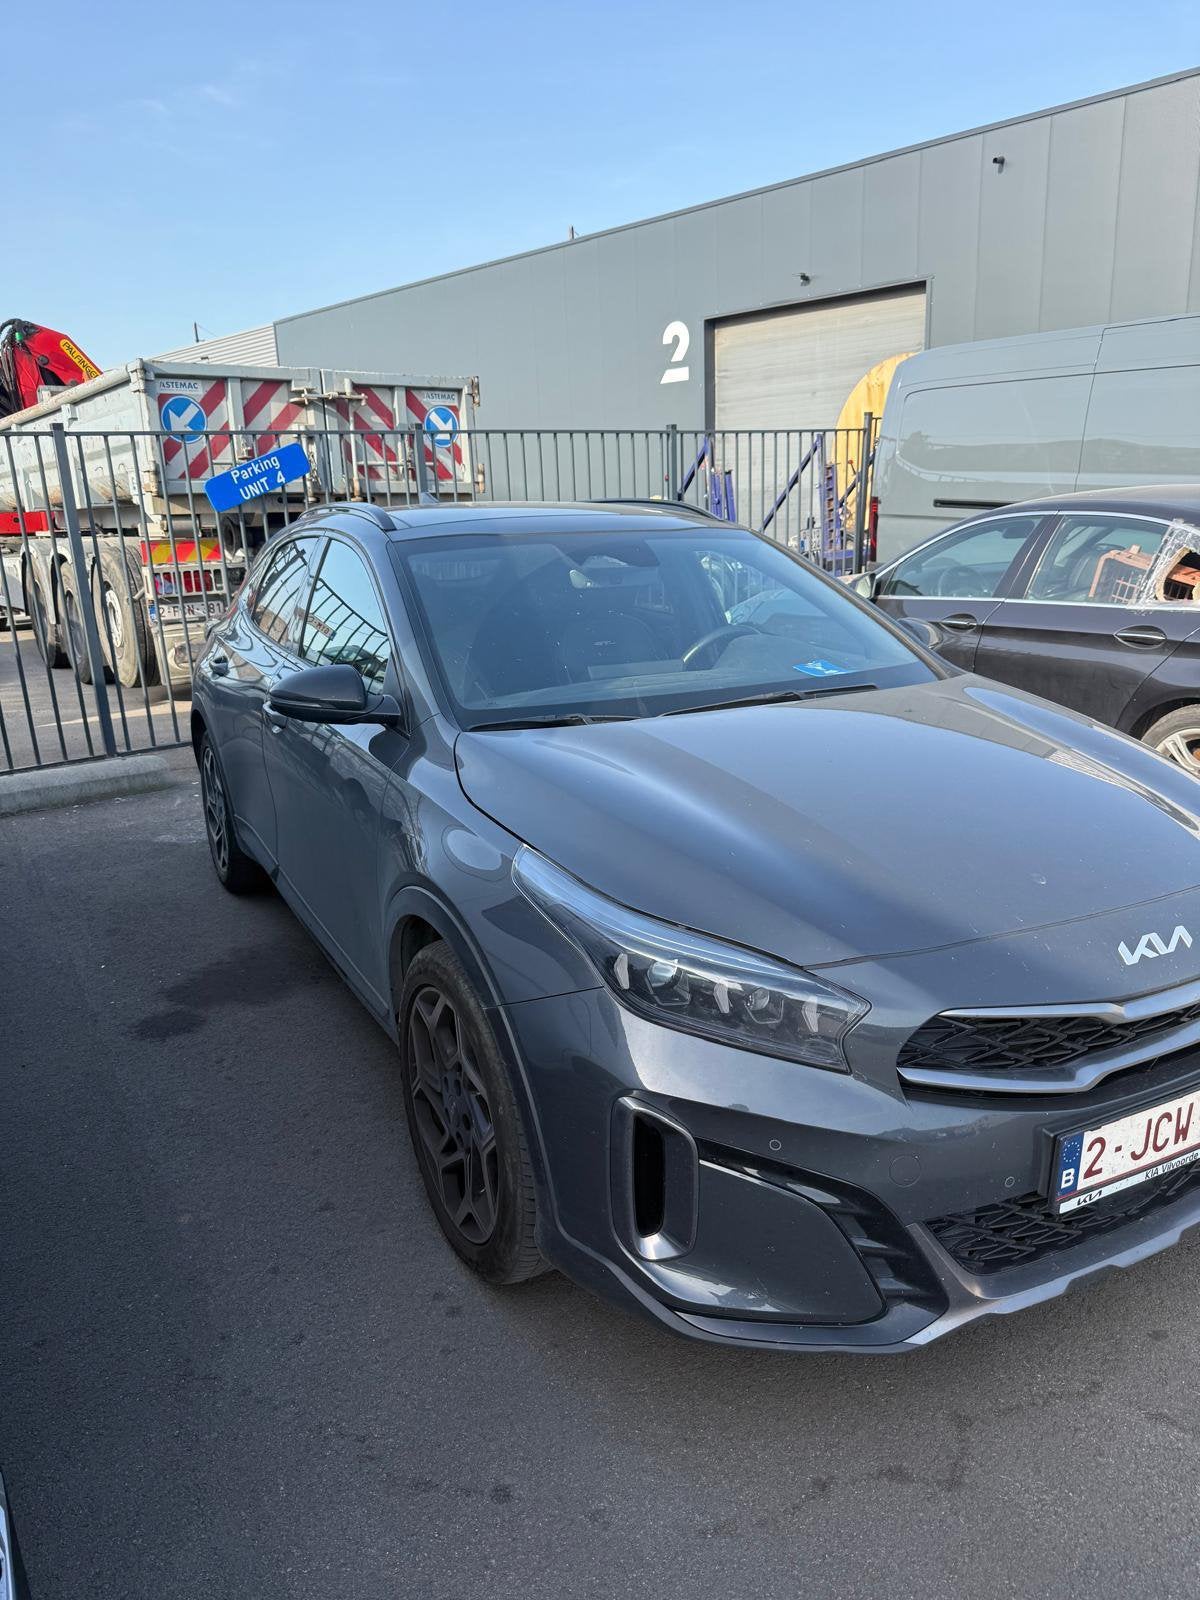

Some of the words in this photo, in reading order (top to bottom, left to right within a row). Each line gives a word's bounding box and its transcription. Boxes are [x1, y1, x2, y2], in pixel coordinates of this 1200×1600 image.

[660, 320, 690, 384] 2
[230, 456, 281, 484] Parking
[240, 477, 270, 500] UNIT
[276, 470, 286, 484] 4
[1117, 925, 1193, 966] KIA
[1060, 1167, 1075, 1190] B
[1144, 1168, 1160, 1180] KIA
[1161, 1152, 1199, 1173] Vilvoorde
